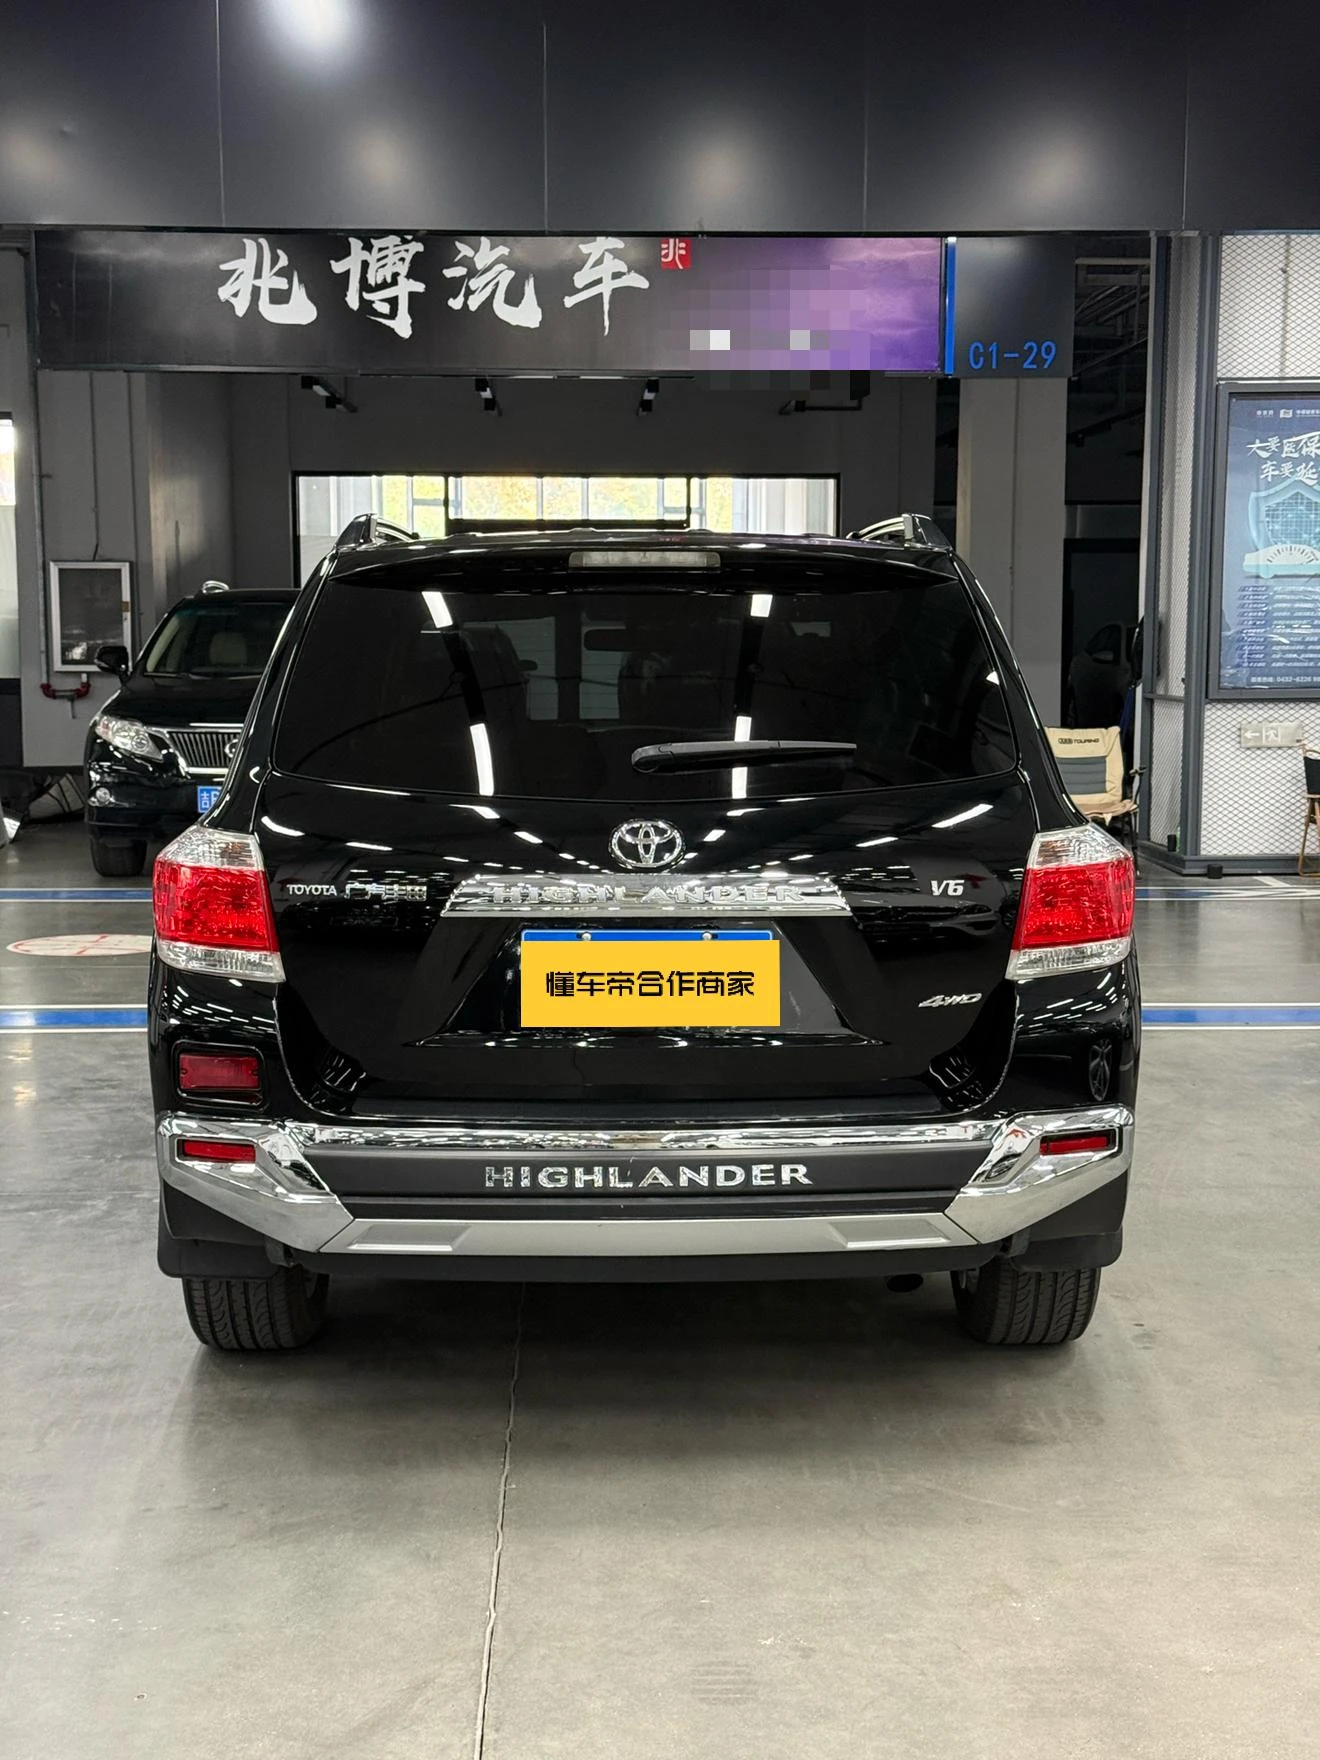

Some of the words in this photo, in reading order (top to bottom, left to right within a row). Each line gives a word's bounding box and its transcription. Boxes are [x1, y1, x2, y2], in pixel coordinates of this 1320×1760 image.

[217, 235, 650, 339] 兆博汽车
[968, 341, 1057, 369] C1-29
[1260, 460, 1320, 487] 车要延
[287, 884, 337, 896] TOYOTA
[492, 885, 806, 904] HIGHLANDER
[930, 880, 965, 896] V6
[918, 993, 982, 1008] 4WD
[484, 1163, 814, 1189] HIGHLANDER
